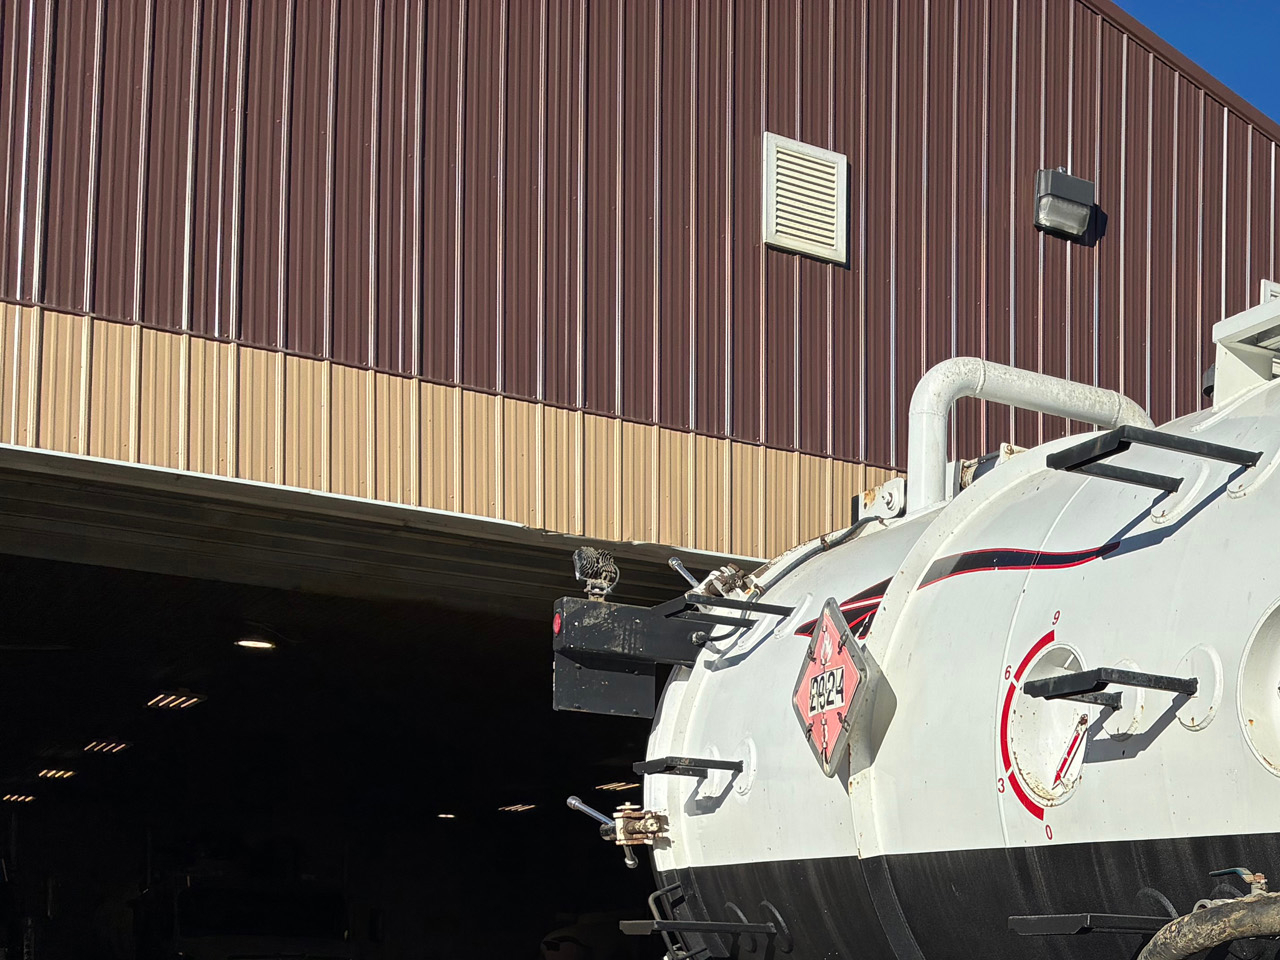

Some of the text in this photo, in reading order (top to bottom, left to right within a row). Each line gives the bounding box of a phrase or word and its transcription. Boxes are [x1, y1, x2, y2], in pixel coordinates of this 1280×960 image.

[1053, 610, 1061, 626] 9
[1004, 665, 1012, 681] 6
[809, 667, 845, 713] 2924
[997, 777, 1006, 794] 3
[1045, 824, 1053, 841] 0
